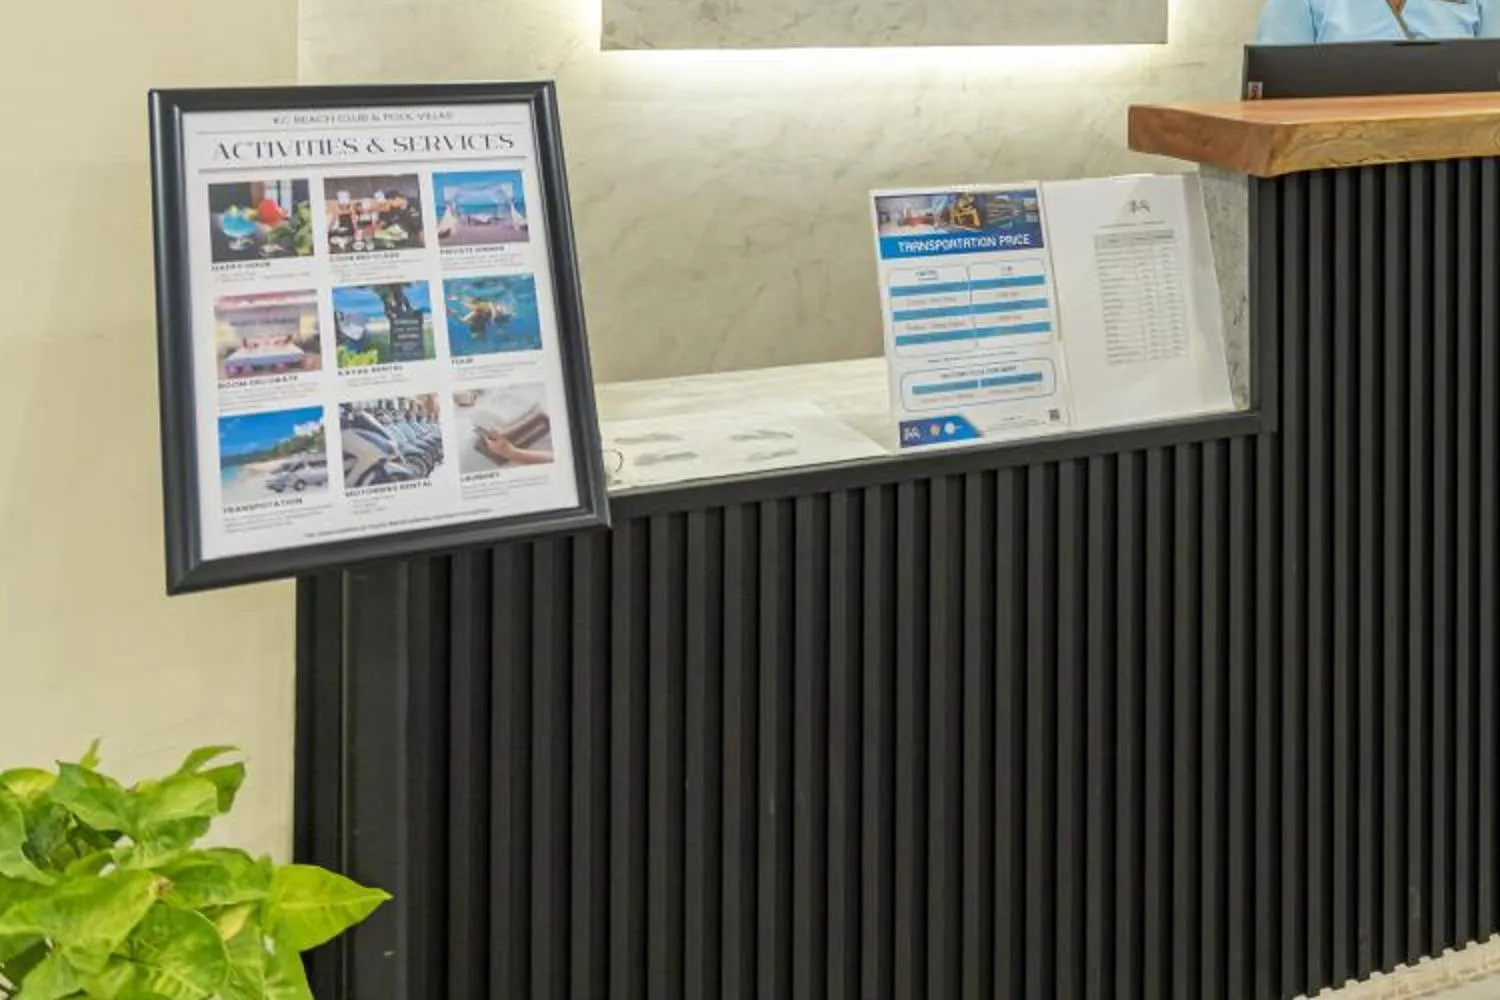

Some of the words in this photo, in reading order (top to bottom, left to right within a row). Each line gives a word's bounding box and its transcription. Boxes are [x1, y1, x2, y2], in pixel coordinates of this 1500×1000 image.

[212, 137, 359, 160] ACTIVITIES
[366, 138, 385, 153] &
[393, 134, 514, 153] SERVICES
[898, 237, 997, 252] TRANSPORTATION
[999, 233, 1031, 246] PRICE
